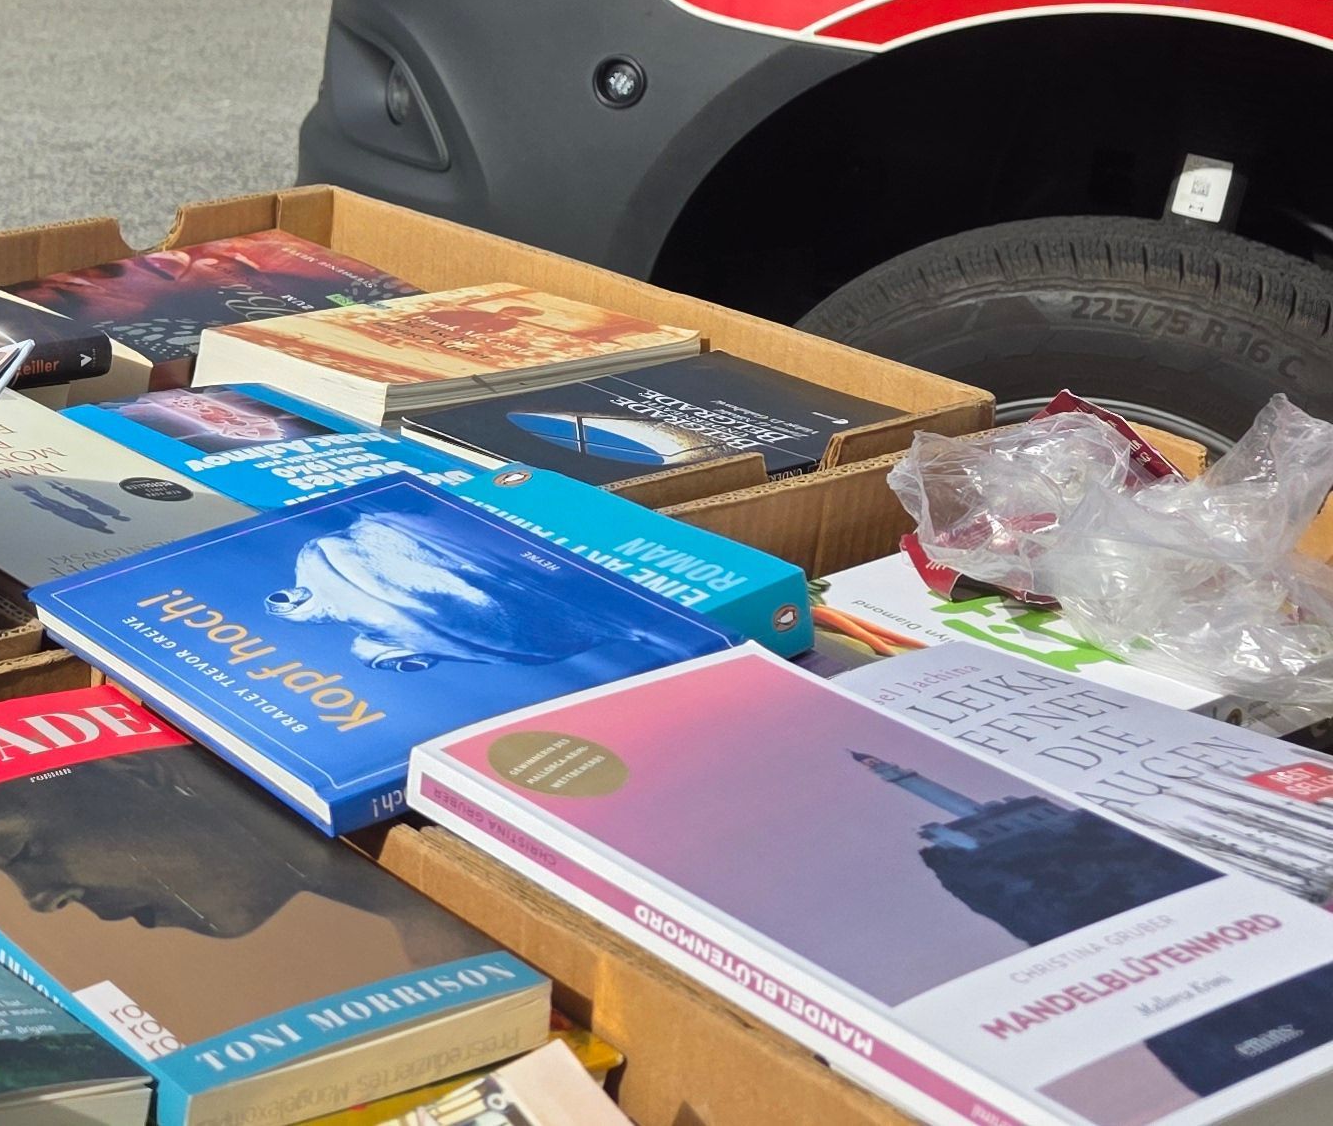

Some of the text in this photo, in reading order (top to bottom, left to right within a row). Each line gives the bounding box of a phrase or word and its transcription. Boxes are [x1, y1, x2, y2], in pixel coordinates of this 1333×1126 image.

[1071, 295, 1306, 381] 225/75 R 16 C
[184, 440, 313, 472] Asimov
[612, 537, 749, 593] ROMAN
[850, 597, 925, 638] Diamond
[120, 615, 308, 734] BRADLEY TREVOR GREIVE
[135, 587, 387, 733] Kopf hoch!
[901, 662, 982, 695] Jachina
[1035, 724, 1155, 771] DIE
[1076, 736, 1264, 808] AUGEN
[432, 787, 557, 868] CHRISTINA GRUBER
[632, 903, 874, 1057] MANDELBLÜTENMORD
[979, 912, 1283, 1040] MANDELBLÜTENMORD
[1008, 913, 1174, 985] CHRISTINA GRUBER
[192, 960, 517, 1075] TONI MORRISON
